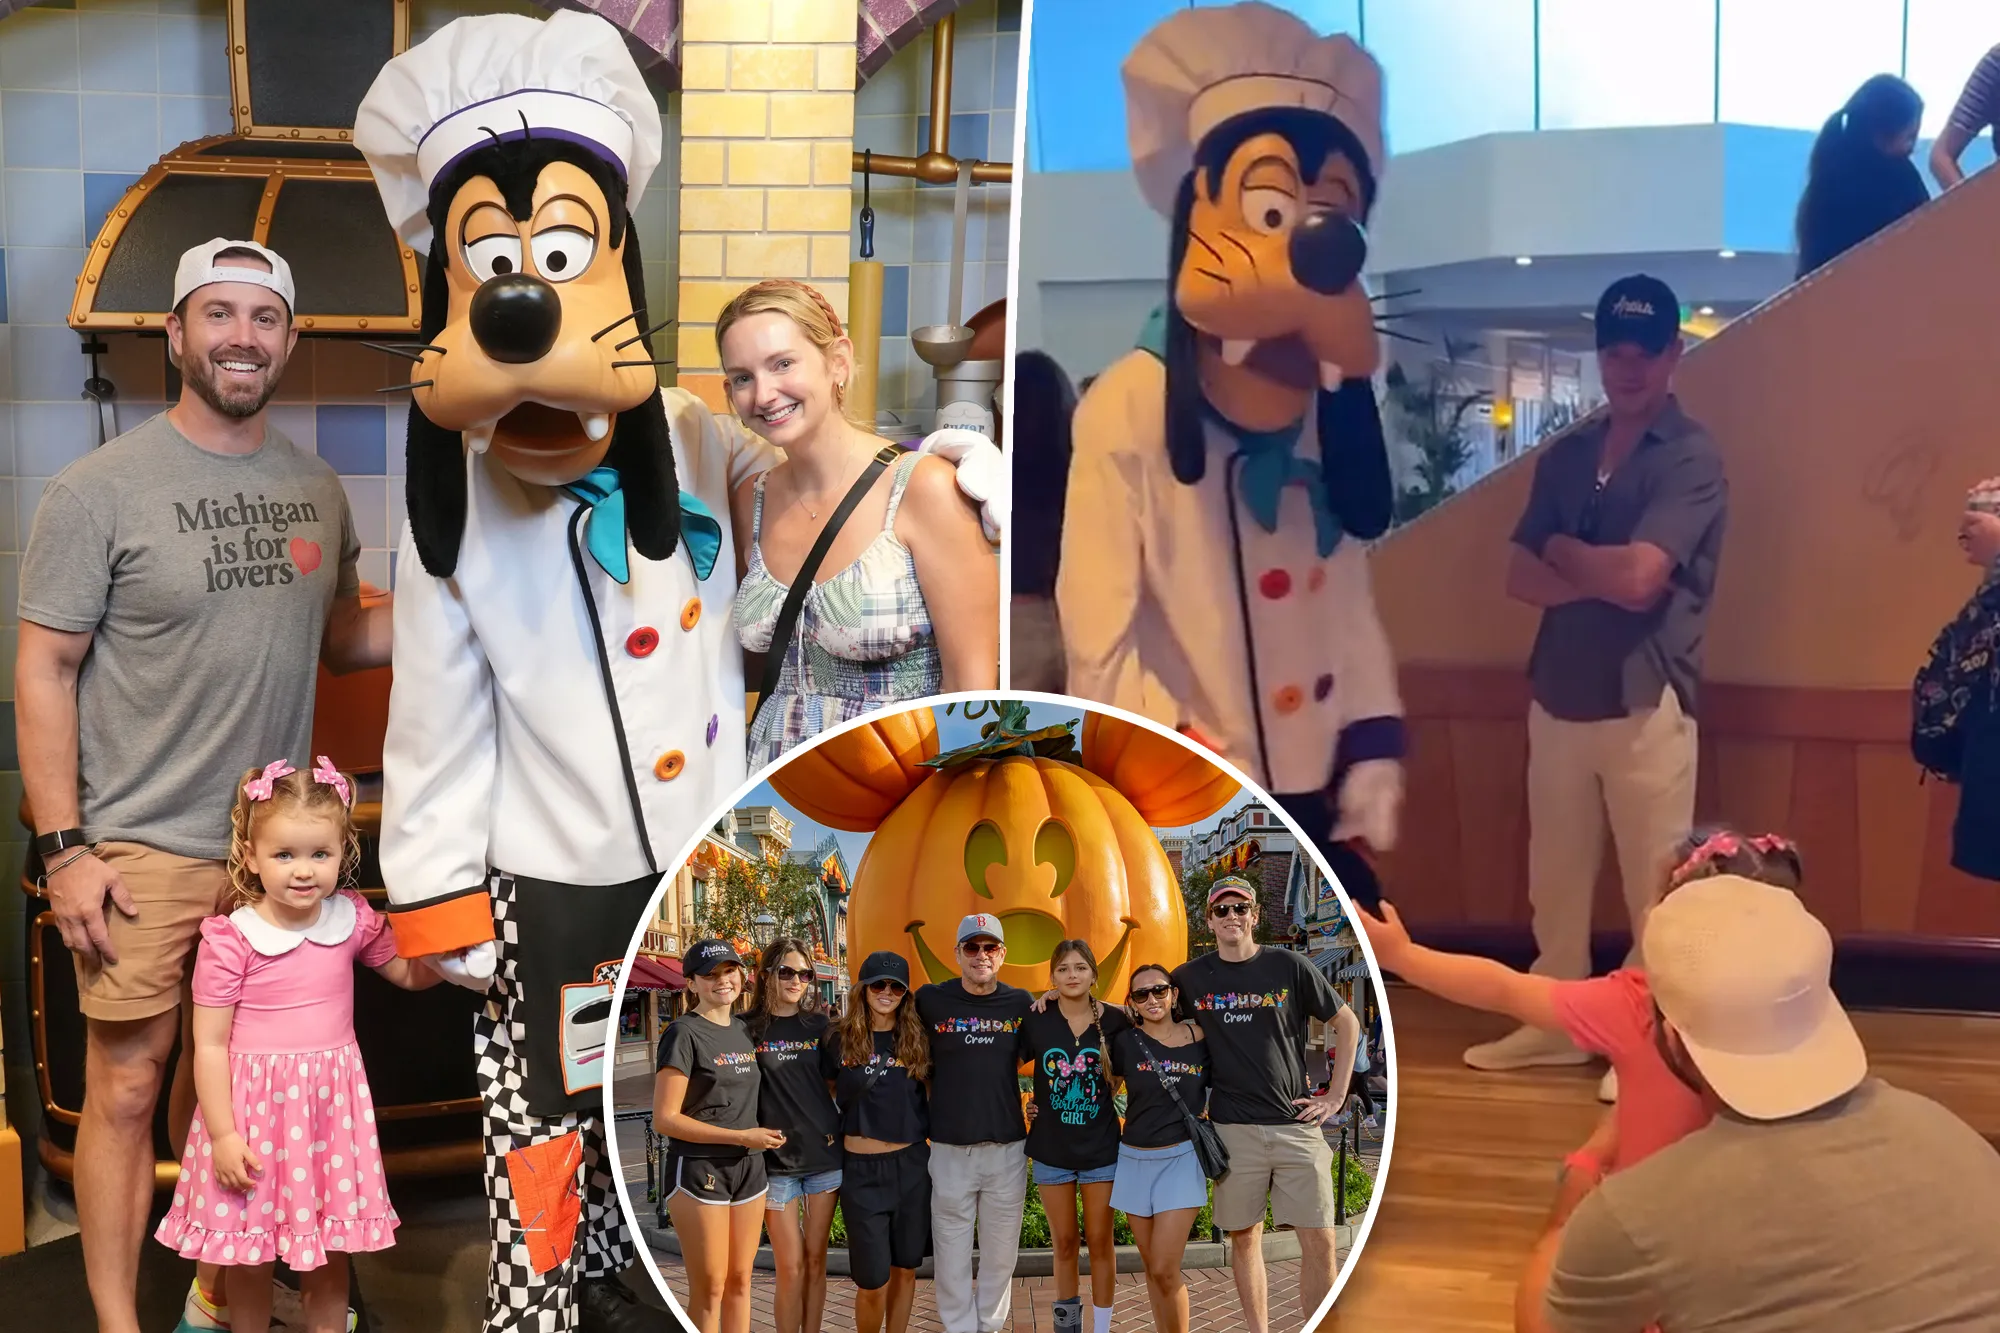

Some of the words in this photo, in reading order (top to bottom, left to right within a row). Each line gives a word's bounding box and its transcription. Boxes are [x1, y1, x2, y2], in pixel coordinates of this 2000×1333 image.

[172, 492, 319, 533] Michigan
[211, 535, 238, 565] is
[243, 526, 288, 562] for
[203, 557, 294, 593] lovers
[976, 915, 987, 928] B
[1194, 988, 1289, 1011] BIRTHDAY
[1223, 1012, 1253, 1024] Crew
[934, 1016, 1023, 1035] BIRTHDAY
[754, 1038, 819, 1053] BIRTHDAY
[964, 1033, 995, 1045] Crew
[777, 1052, 798, 1061] Crew
[734, 1065, 751, 1075] Crew
[864, 1066, 888, 1076] Crw
[1049, 1093, 1101, 1119] Birthday
[1061, 1111, 1087, 1125] GIRL
